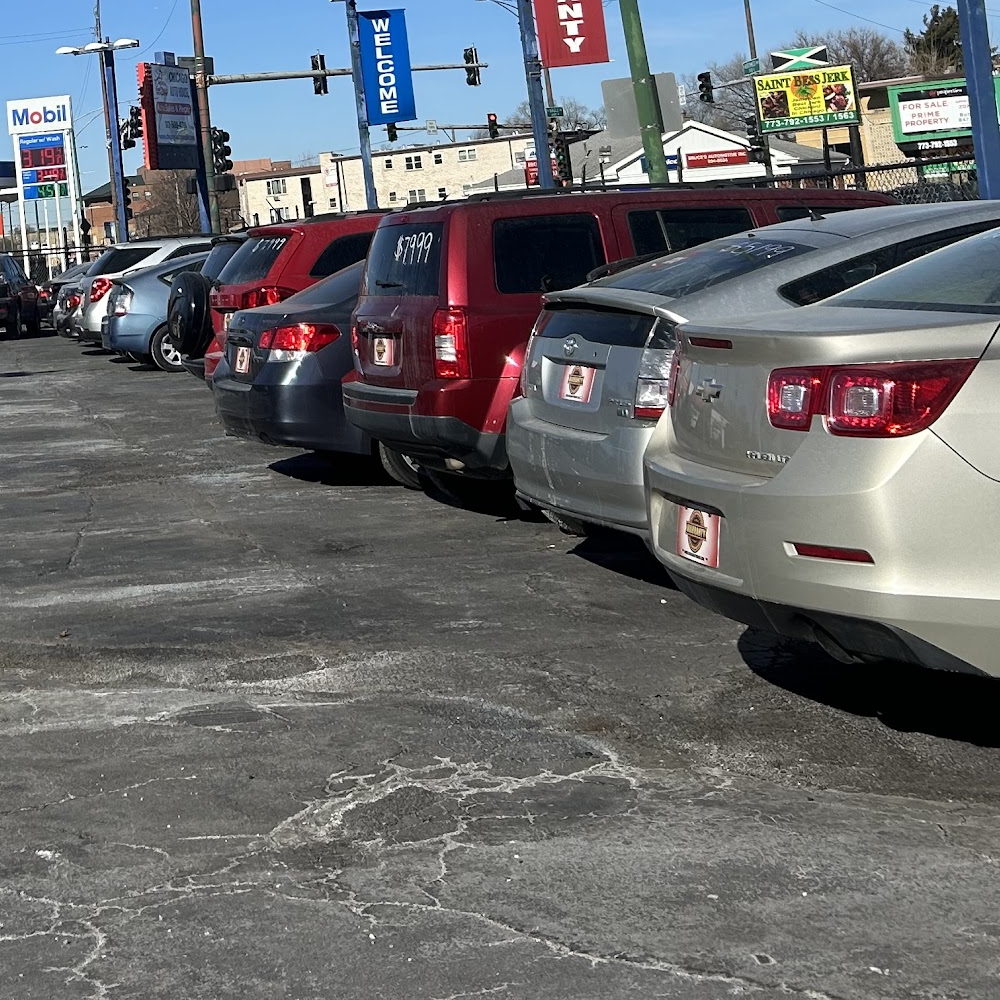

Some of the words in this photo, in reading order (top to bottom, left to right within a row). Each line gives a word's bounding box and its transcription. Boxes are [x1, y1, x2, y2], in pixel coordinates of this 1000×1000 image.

[371, 18, 399, 115] WELCOME
[757, 78, 792, 92] SAINT
[793, 74, 821, 87] BESS
[821, 71, 850, 84] JERK
[12, 104, 67, 126] Mobil
[902, 102, 922, 111] FOR
[924, 100, 948, 109] SALE
[911, 111, 941, 119] PRIME
[764, 115, 825, 129] 773-792-1553
[832, 111, 855, 121] 1563
[905, 117, 949, 127] PROPERTY
[394, 231, 433, 266] $7999
